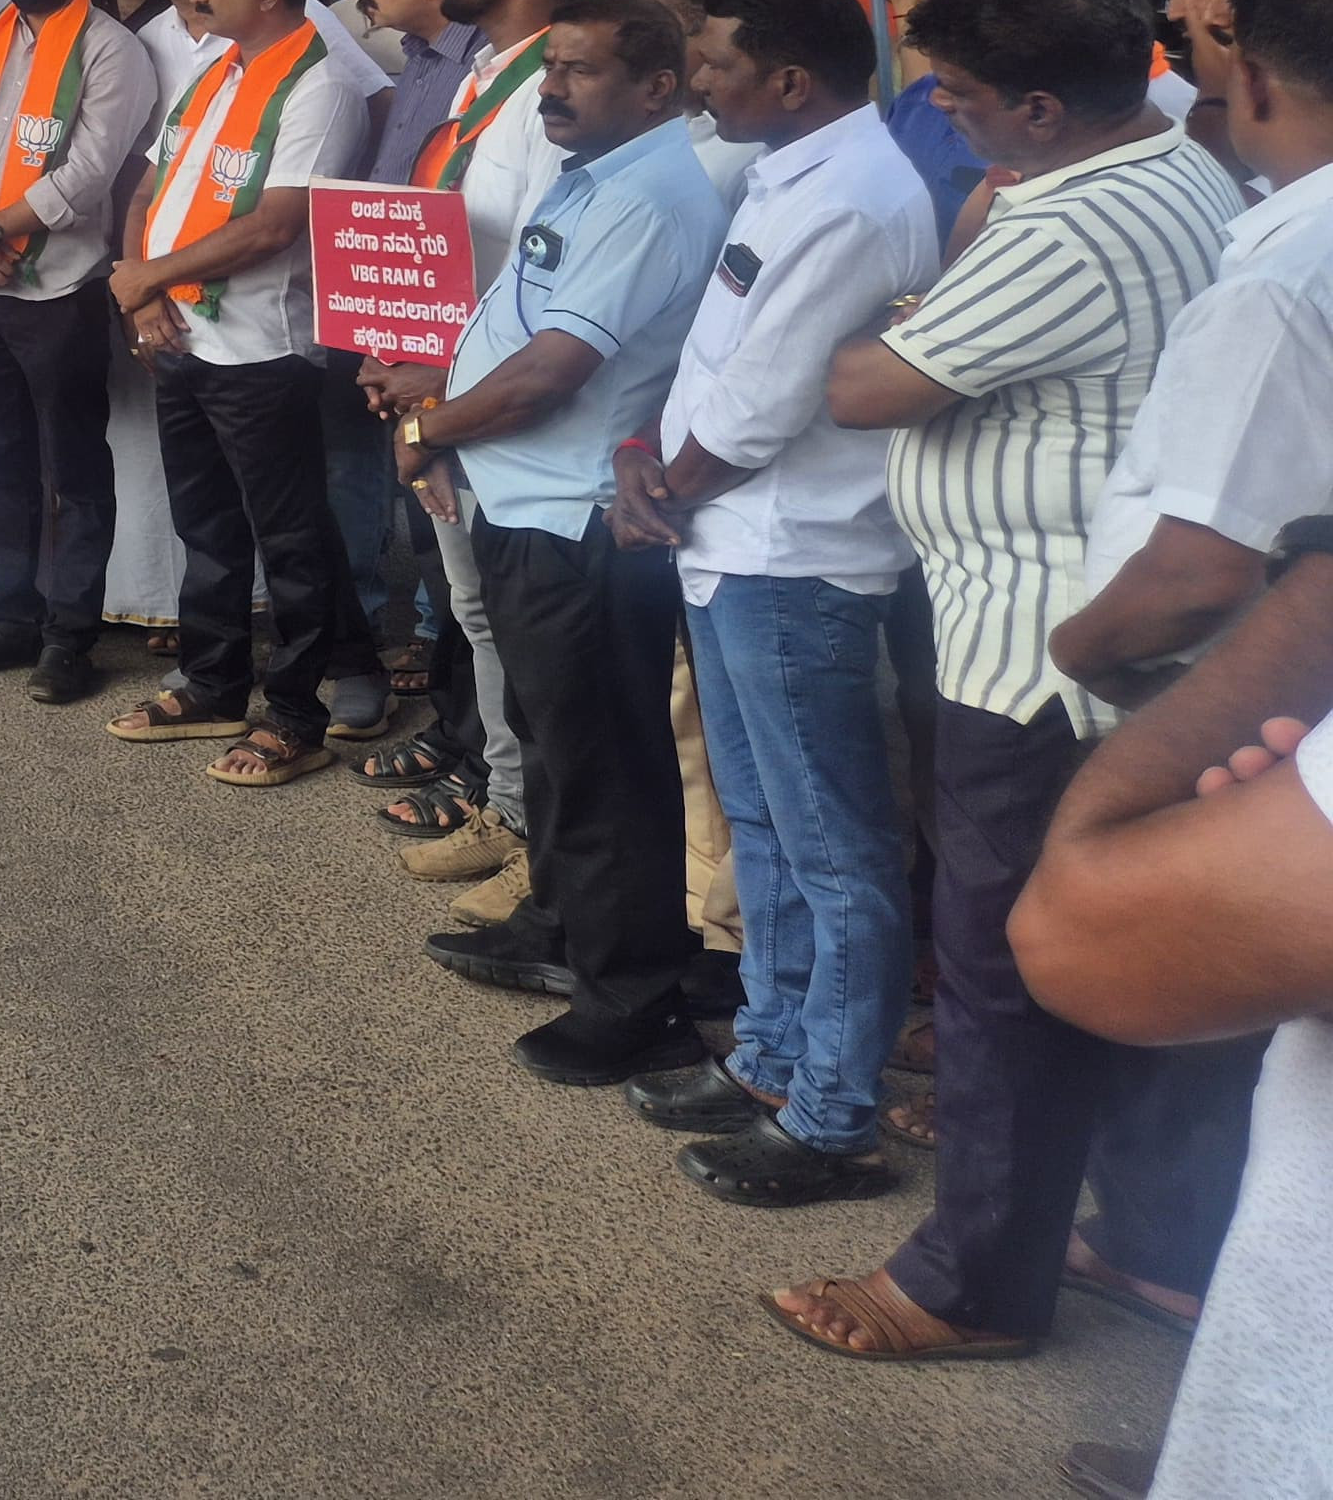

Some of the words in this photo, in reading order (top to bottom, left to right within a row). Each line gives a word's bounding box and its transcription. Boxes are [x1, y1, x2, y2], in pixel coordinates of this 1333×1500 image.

[351, 199, 385, 218] ಲಂಚ
[389, 200, 426, 230] ಮುಕ್ತ
[334, 227, 379, 249] ನರೇಗಾ
[383, 231, 422, 263] ನಮ್ಮ
[421, 234, 448, 256] ಗುರಿ
[351, 264, 379, 283] VBG
[382, 267, 419, 287] RAM
[423, 270, 436, 288] G
[328, 292, 376, 315] ಮೂಲಕ
[379, 298, 468, 325] ಬದಲಾಗಲಿದೆ
[353, 326, 398, 358] ಹಳ್ಳಿಯ
[401, 332, 445, 356] ಹಾದಿ!
